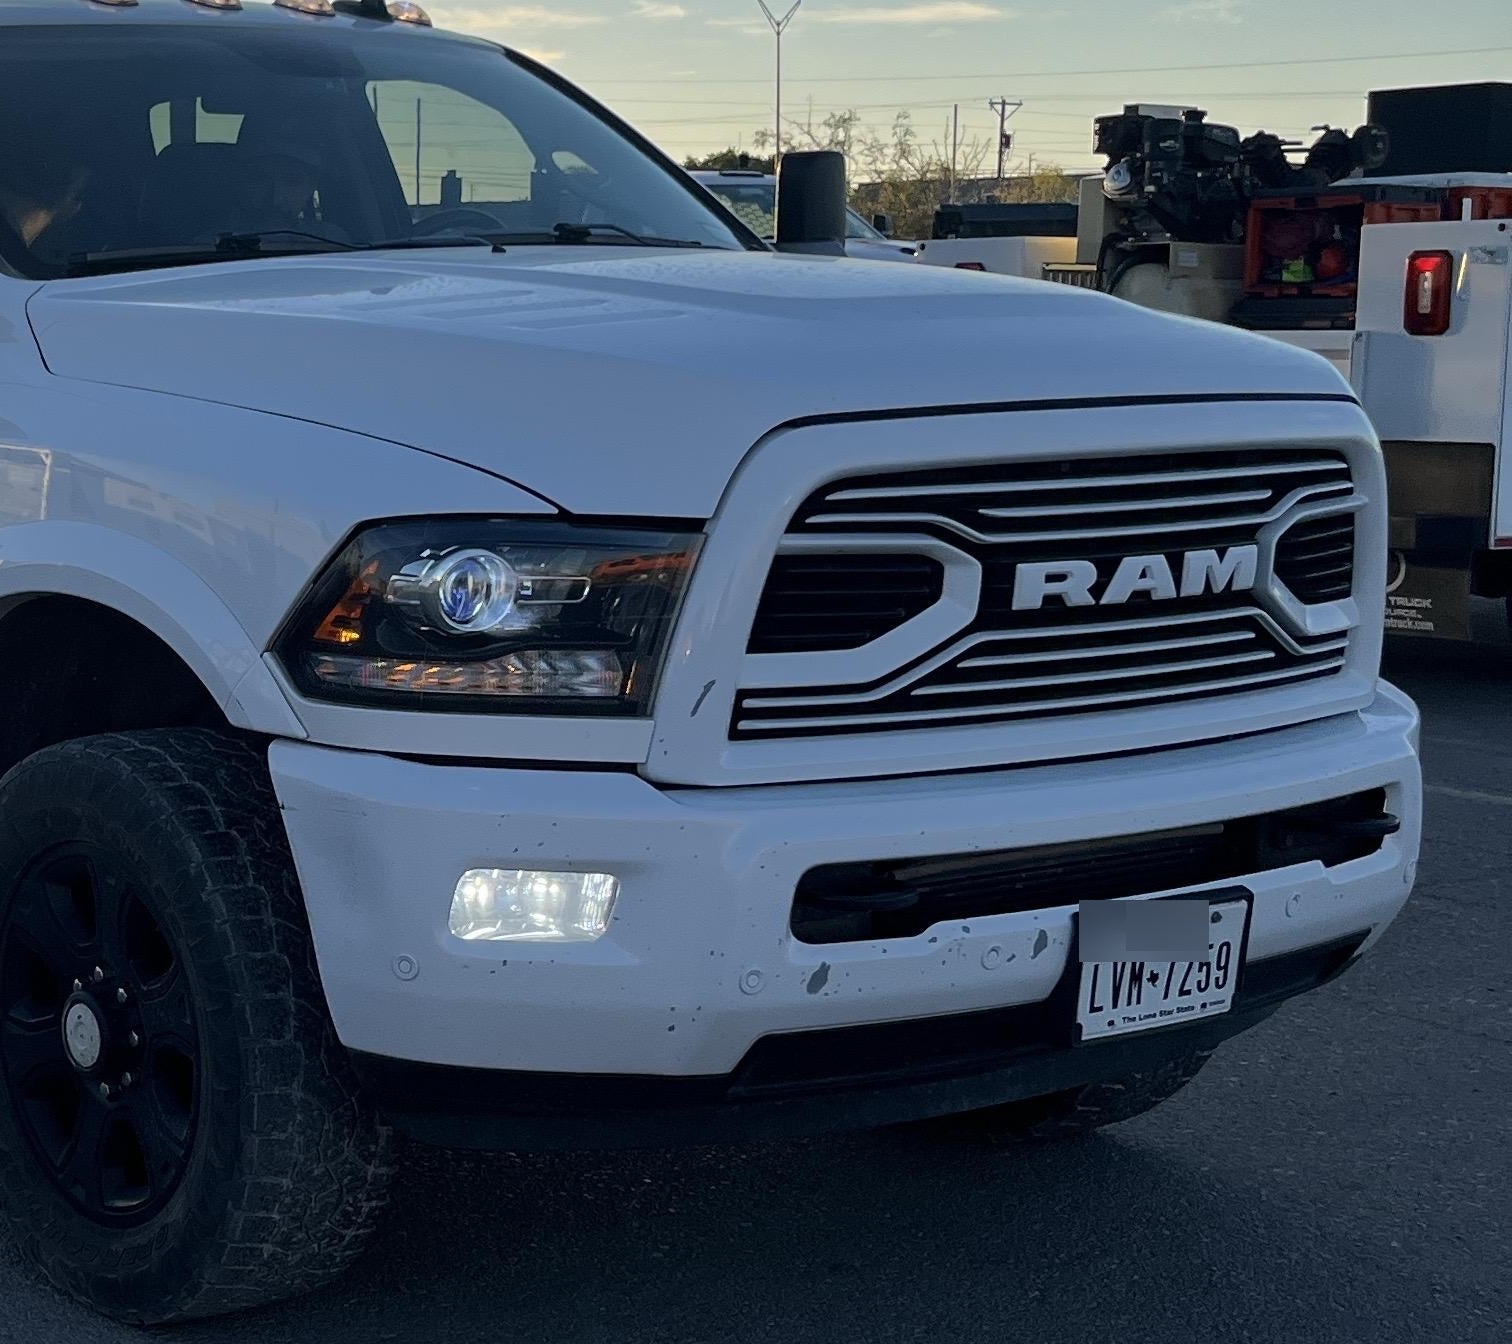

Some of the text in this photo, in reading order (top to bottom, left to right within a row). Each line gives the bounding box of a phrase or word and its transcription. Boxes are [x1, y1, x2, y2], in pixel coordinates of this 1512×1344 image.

[1011, 544, 1258, 611] RAM
[1388, 596, 1433, 609] TRUCK
[1121, 1005, 1196, 1025] The Lone Star State
